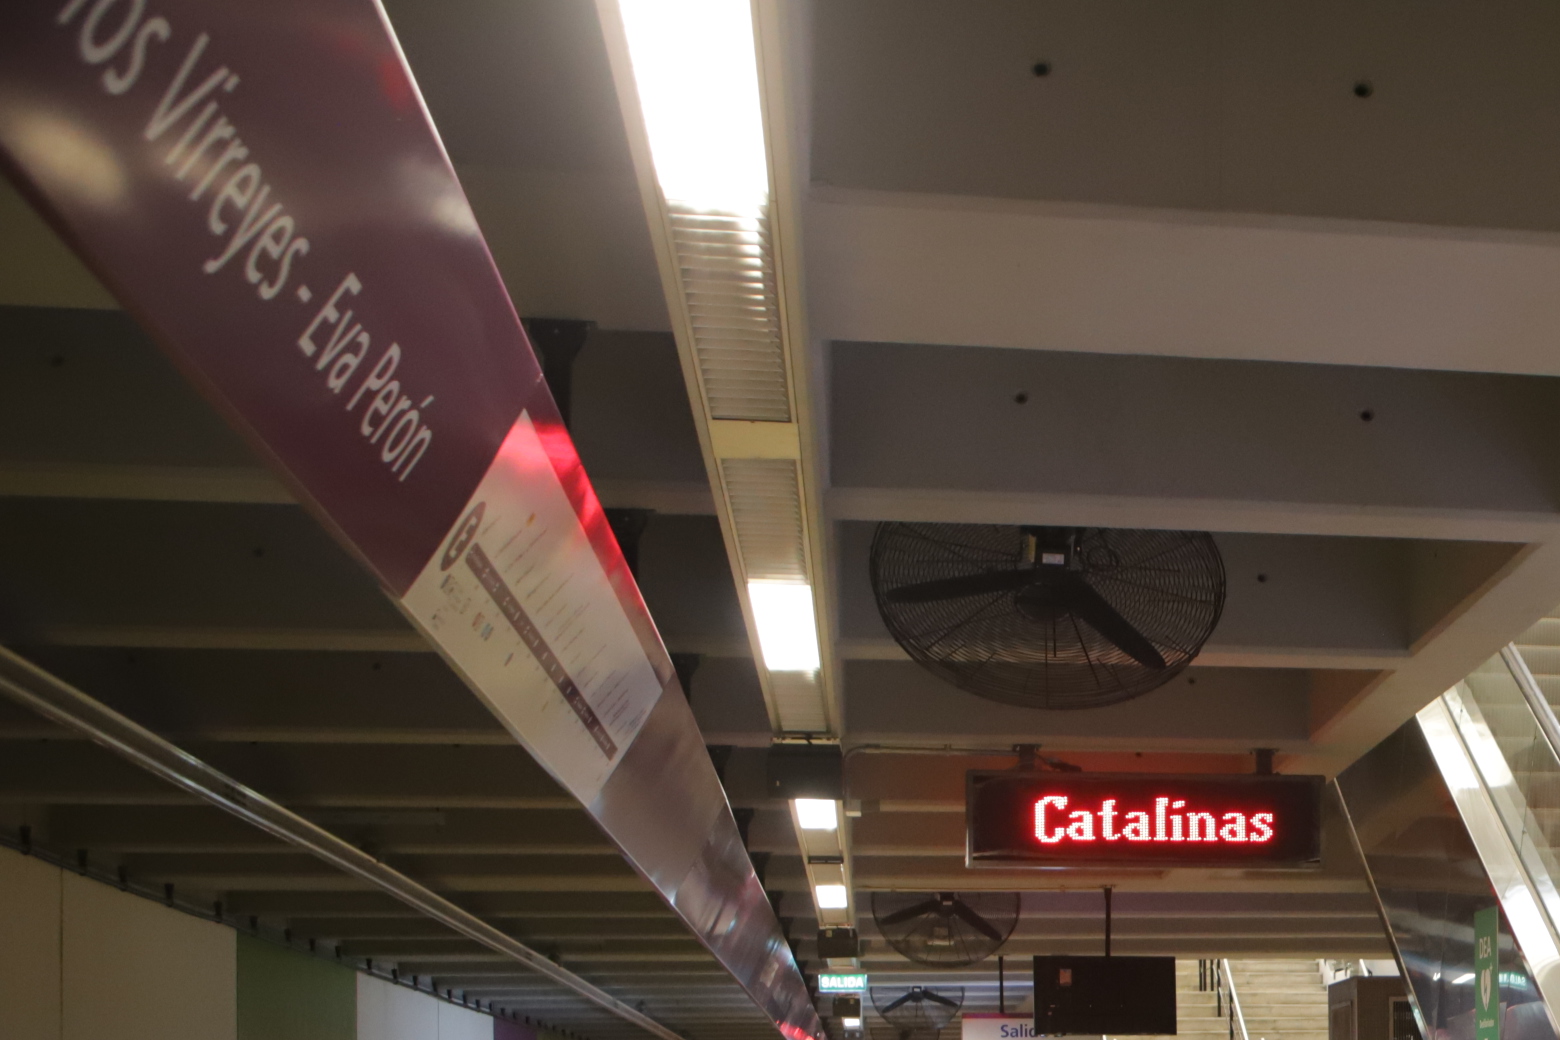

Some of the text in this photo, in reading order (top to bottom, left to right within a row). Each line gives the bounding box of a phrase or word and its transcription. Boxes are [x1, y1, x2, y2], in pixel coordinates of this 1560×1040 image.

[57, 0, 172, 95] os
[144, 31, 310, 300] Virreyes
[297, 272, 370, 394] Eva
[346, 342, 435, 482] Perón
[1479, 936, 1492, 959] DEA
[821, 976, 864, 989] SALIDA
[1001, 1024, 1037, 1039] Sali
